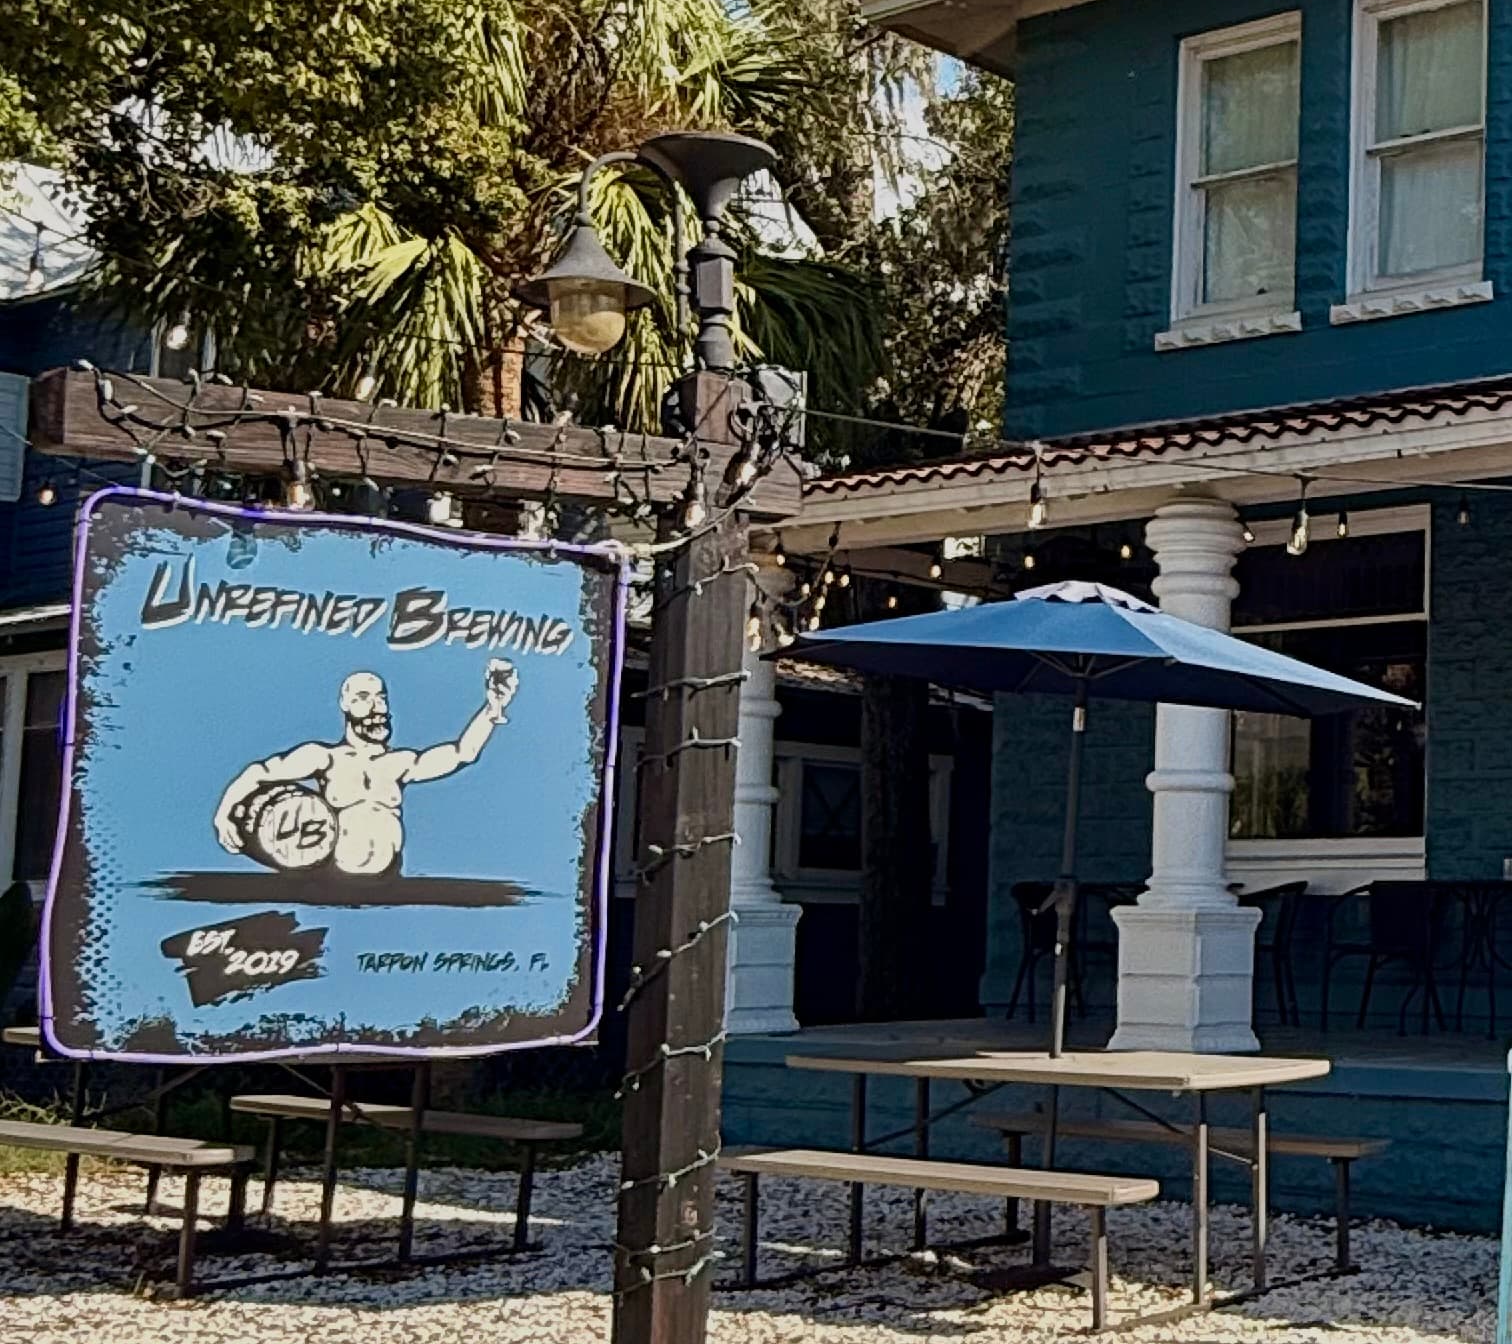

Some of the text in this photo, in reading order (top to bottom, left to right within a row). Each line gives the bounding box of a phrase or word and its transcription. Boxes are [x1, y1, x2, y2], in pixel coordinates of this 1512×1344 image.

[141, 553, 574, 656] UNREFINED BREWING
[276, 802, 327, 849] UB
[186, 928, 236, 956] EST.
[224, 950, 300, 975] 2019
[357, 952, 428, 973] TARPON
[433, 951, 519, 973] SPRINGS,
